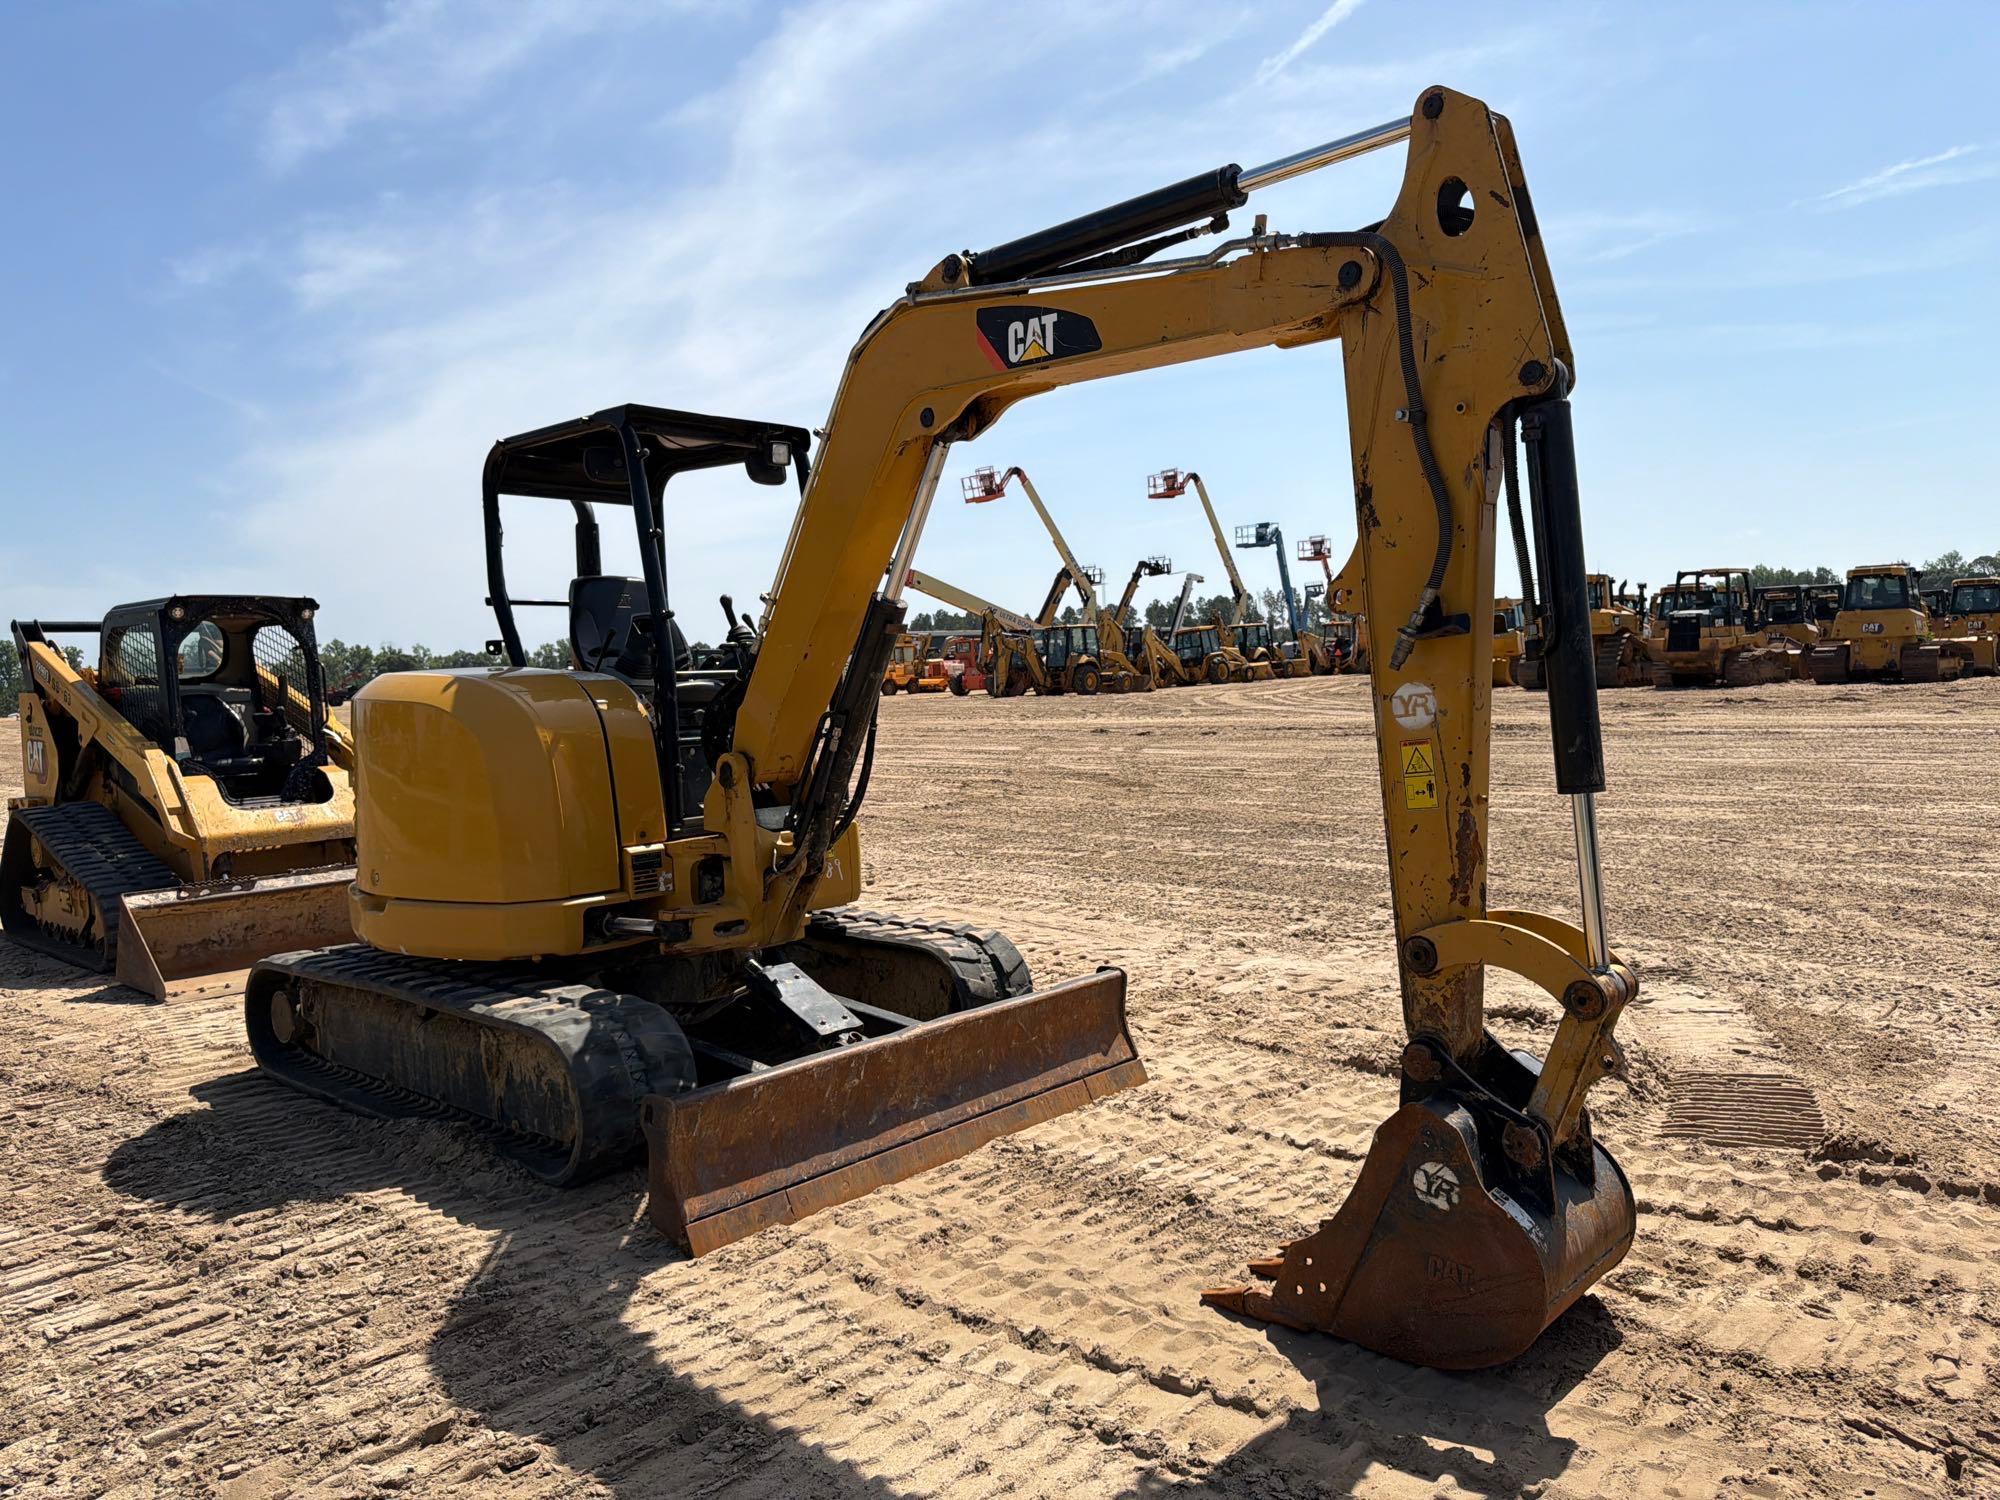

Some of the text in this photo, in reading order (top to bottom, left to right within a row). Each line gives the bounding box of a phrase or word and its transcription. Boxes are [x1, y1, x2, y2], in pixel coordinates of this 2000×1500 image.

[1008, 313, 1057, 363] CAT
[1862, 623, 1881, 633] CAT
[1968, 621, 1982, 629] CAT
[1393, 691, 1436, 717] YR
[27, 740, 43, 773] CAT
[1414, 1164, 1460, 1205] YR
[1427, 1254, 1473, 1288] CAT
